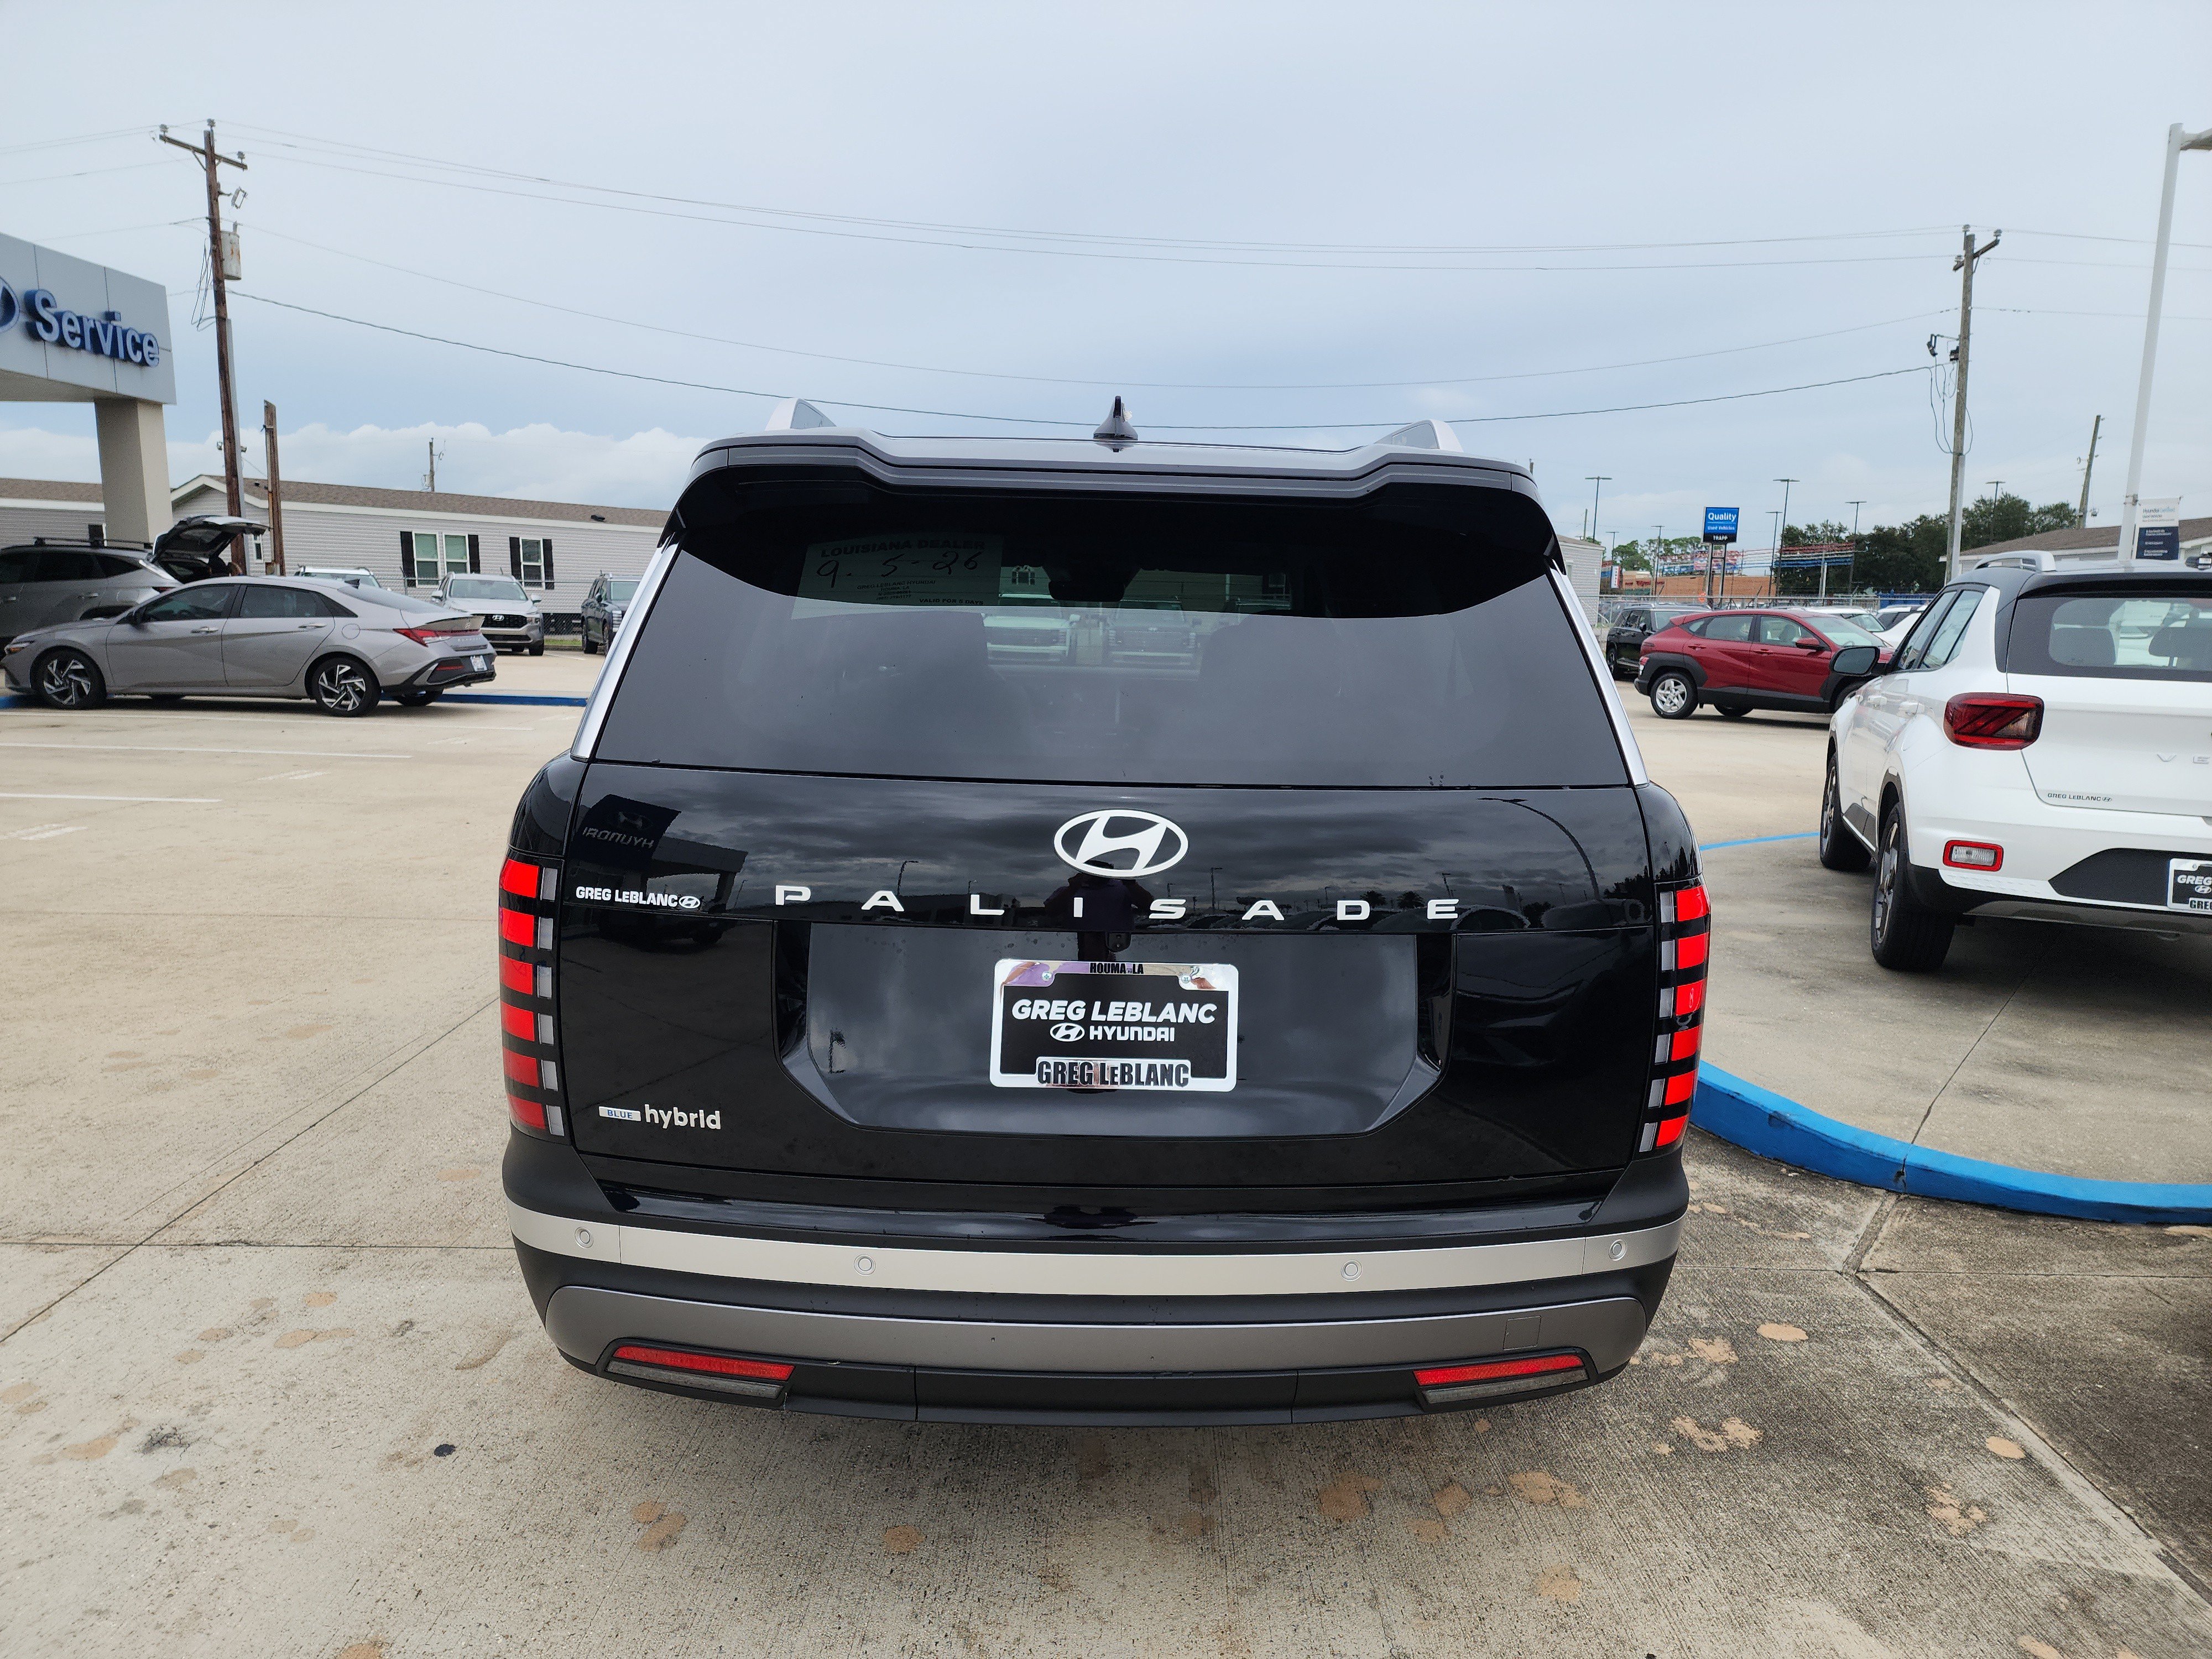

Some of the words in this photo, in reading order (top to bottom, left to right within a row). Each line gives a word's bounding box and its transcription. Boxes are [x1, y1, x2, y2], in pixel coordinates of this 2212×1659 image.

[24, 289, 160, 367] Service
[1708, 512, 1737, 522] Quality
[821, 540, 912, 558] LOUISIANA
[917, 539, 986, 550] DEALER
[2177, 874, 2212, 885] GREG
[576, 886, 612, 901] GREG
[775, 884, 1459, 922] PALISADE
[1133, 963, 1144, 975] LA
[1011, 999, 1087, 1021] GREG
[1091, 1001, 1218, 1024] LEBLANC
[1089, 1025, 1175, 1042] HYUNDAI
[1037, 1060, 1094, 1086] GREG
[607, 1109, 633, 1119] BLUE
[644, 1104, 722, 1130] hybrid
